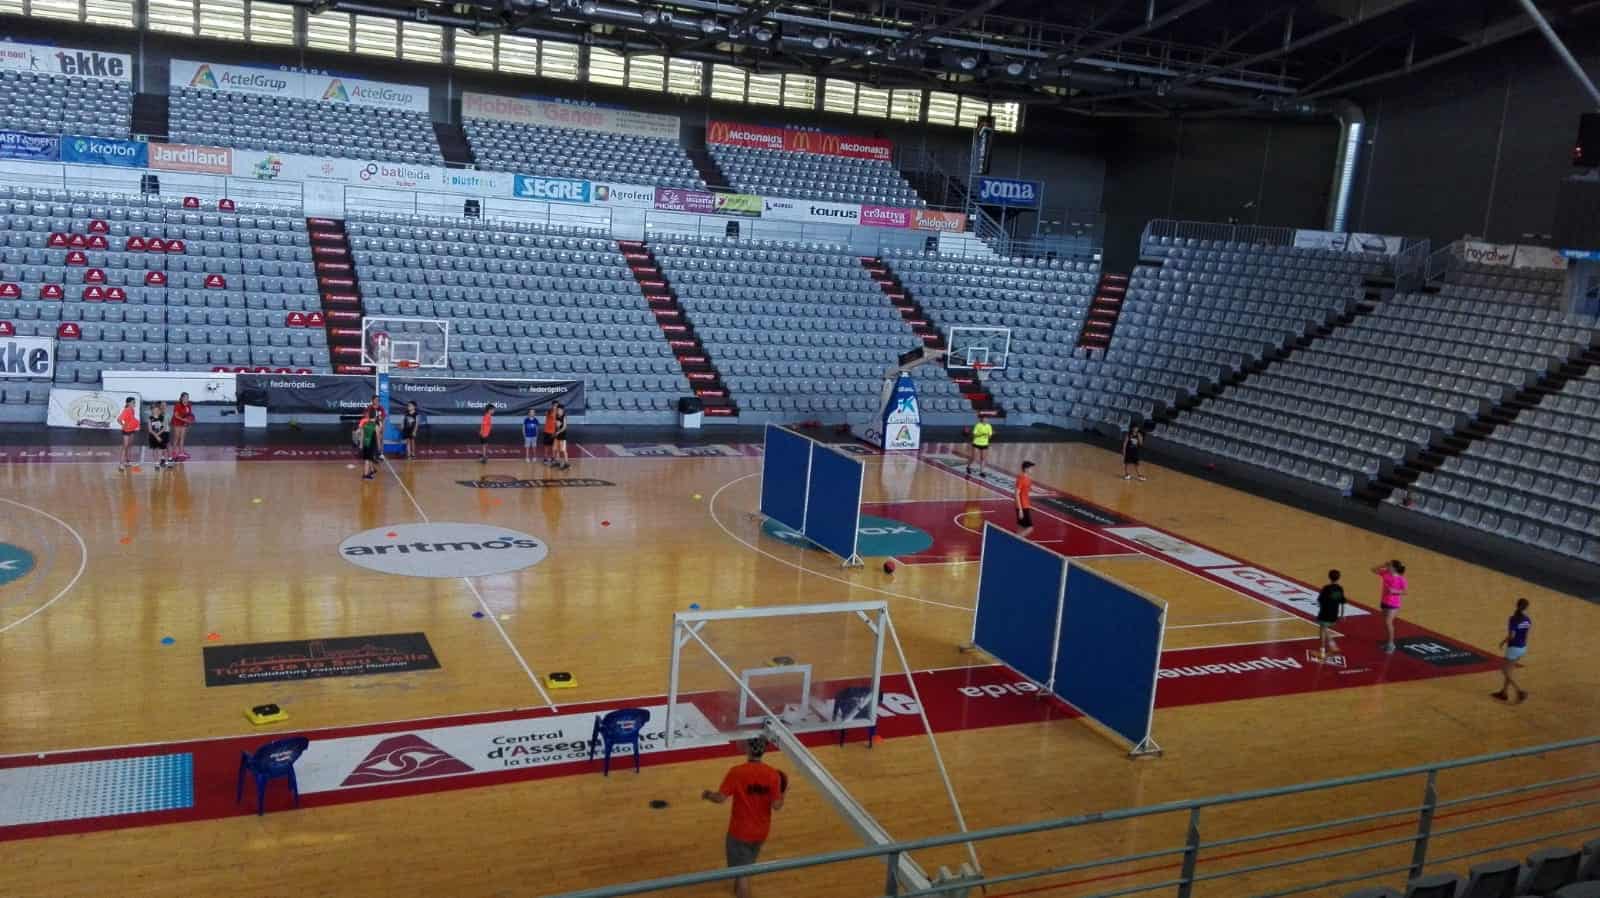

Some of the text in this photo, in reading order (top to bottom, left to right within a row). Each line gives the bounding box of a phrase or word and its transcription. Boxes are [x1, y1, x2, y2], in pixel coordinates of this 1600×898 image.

[220, 71, 287, 91] ActelGrup
[352, 85, 413, 105] ActelGrup
[729, 130, 783, 144] McDonald's
[90, 140, 136, 156] kroton
[840, 142, 889, 155] McDonald's
[154, 147, 228, 166] Jardiland
[521, 178, 584, 199] SEGRE
[810, 205, 858, 219] taurus
[492, 729, 564, 744] Central
[504, 759, 520, 767] la
[525, 754, 562, 764] teva
